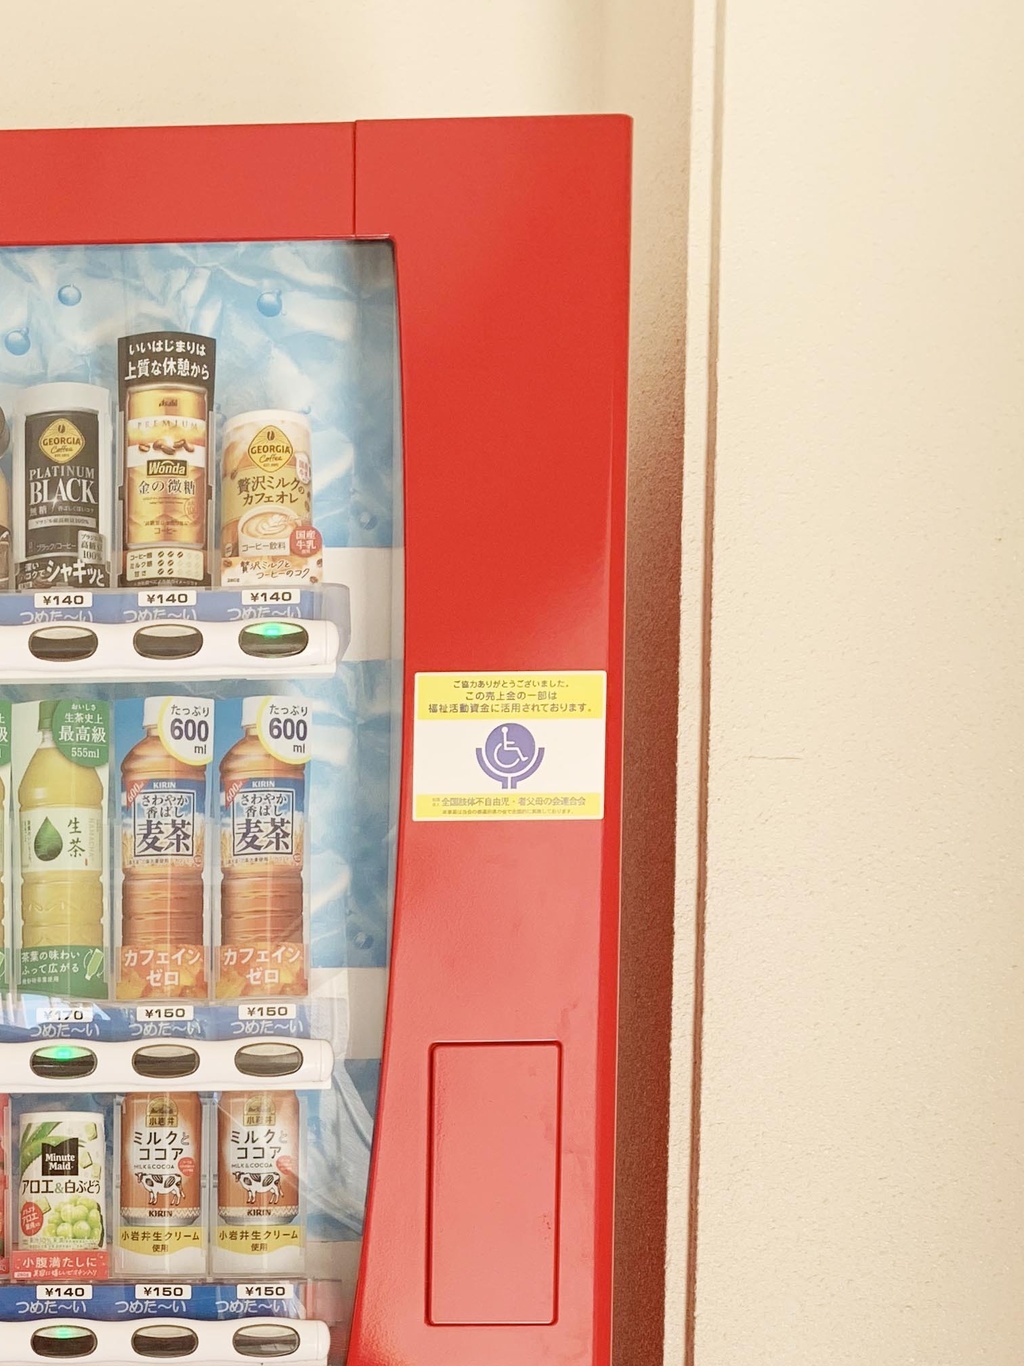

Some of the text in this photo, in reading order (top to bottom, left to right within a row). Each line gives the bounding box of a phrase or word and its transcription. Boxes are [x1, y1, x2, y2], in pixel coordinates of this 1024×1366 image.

[129, 339, 206, 356] いいはじまりは
[124, 357, 209, 380] 上質な休憩から
[29, 466, 95, 481] PLATINUM
[148, 461, 186, 475] Wonda
[29, 478, 98, 506] BLACK
[139, 479, 195, 496] 金の微糖
[243, 492, 299, 506] カフェオレ
[43, 594, 85, 605] ¥140
[146, 593, 188, 603] ¥140
[250, 591, 292, 602] ¥140
[453, 680, 570, 689] ご協力ありがとうございました。
[465, 691, 558, 701] この売上金の一部は
[170, 704, 210, 717] たっぷり
[428, 703, 592, 713] 福祉活動資金に活用されております。
[170, 718, 209, 742] 600
[269, 717, 308, 741] 600
[194, 744, 207, 754] ml
[153, 781, 176, 789] KIRIN
[141, 794, 188, 806] さわやか
[137, 819, 191, 853] 麦茶
[236, 818, 291, 852] 麦茶
[125, 948, 201, 966] カフェイン
[146, 970, 179, 987] ゼロ
[145, 1007, 186, 1018] ¥150
[247, 1006, 288, 1017] ¥150
[133, 1130, 190, 1145] ミルクと
[45, 1153, 75, 1162] Minute
[139, 1148, 183, 1161] ココア
[48, 1161, 74, 1171] Maid
[22, 1179, 100, 1195] アロエ&白ぶどう
[121, 1230, 199, 1241] 小岩井生クリーム
[23, 1257, 97, 1268] 小腹満たしに
[45, 1287, 85, 1297] ¥140
[143, 1286, 184, 1297] ¥150
[245, 1286, 286, 1296] ¥150
